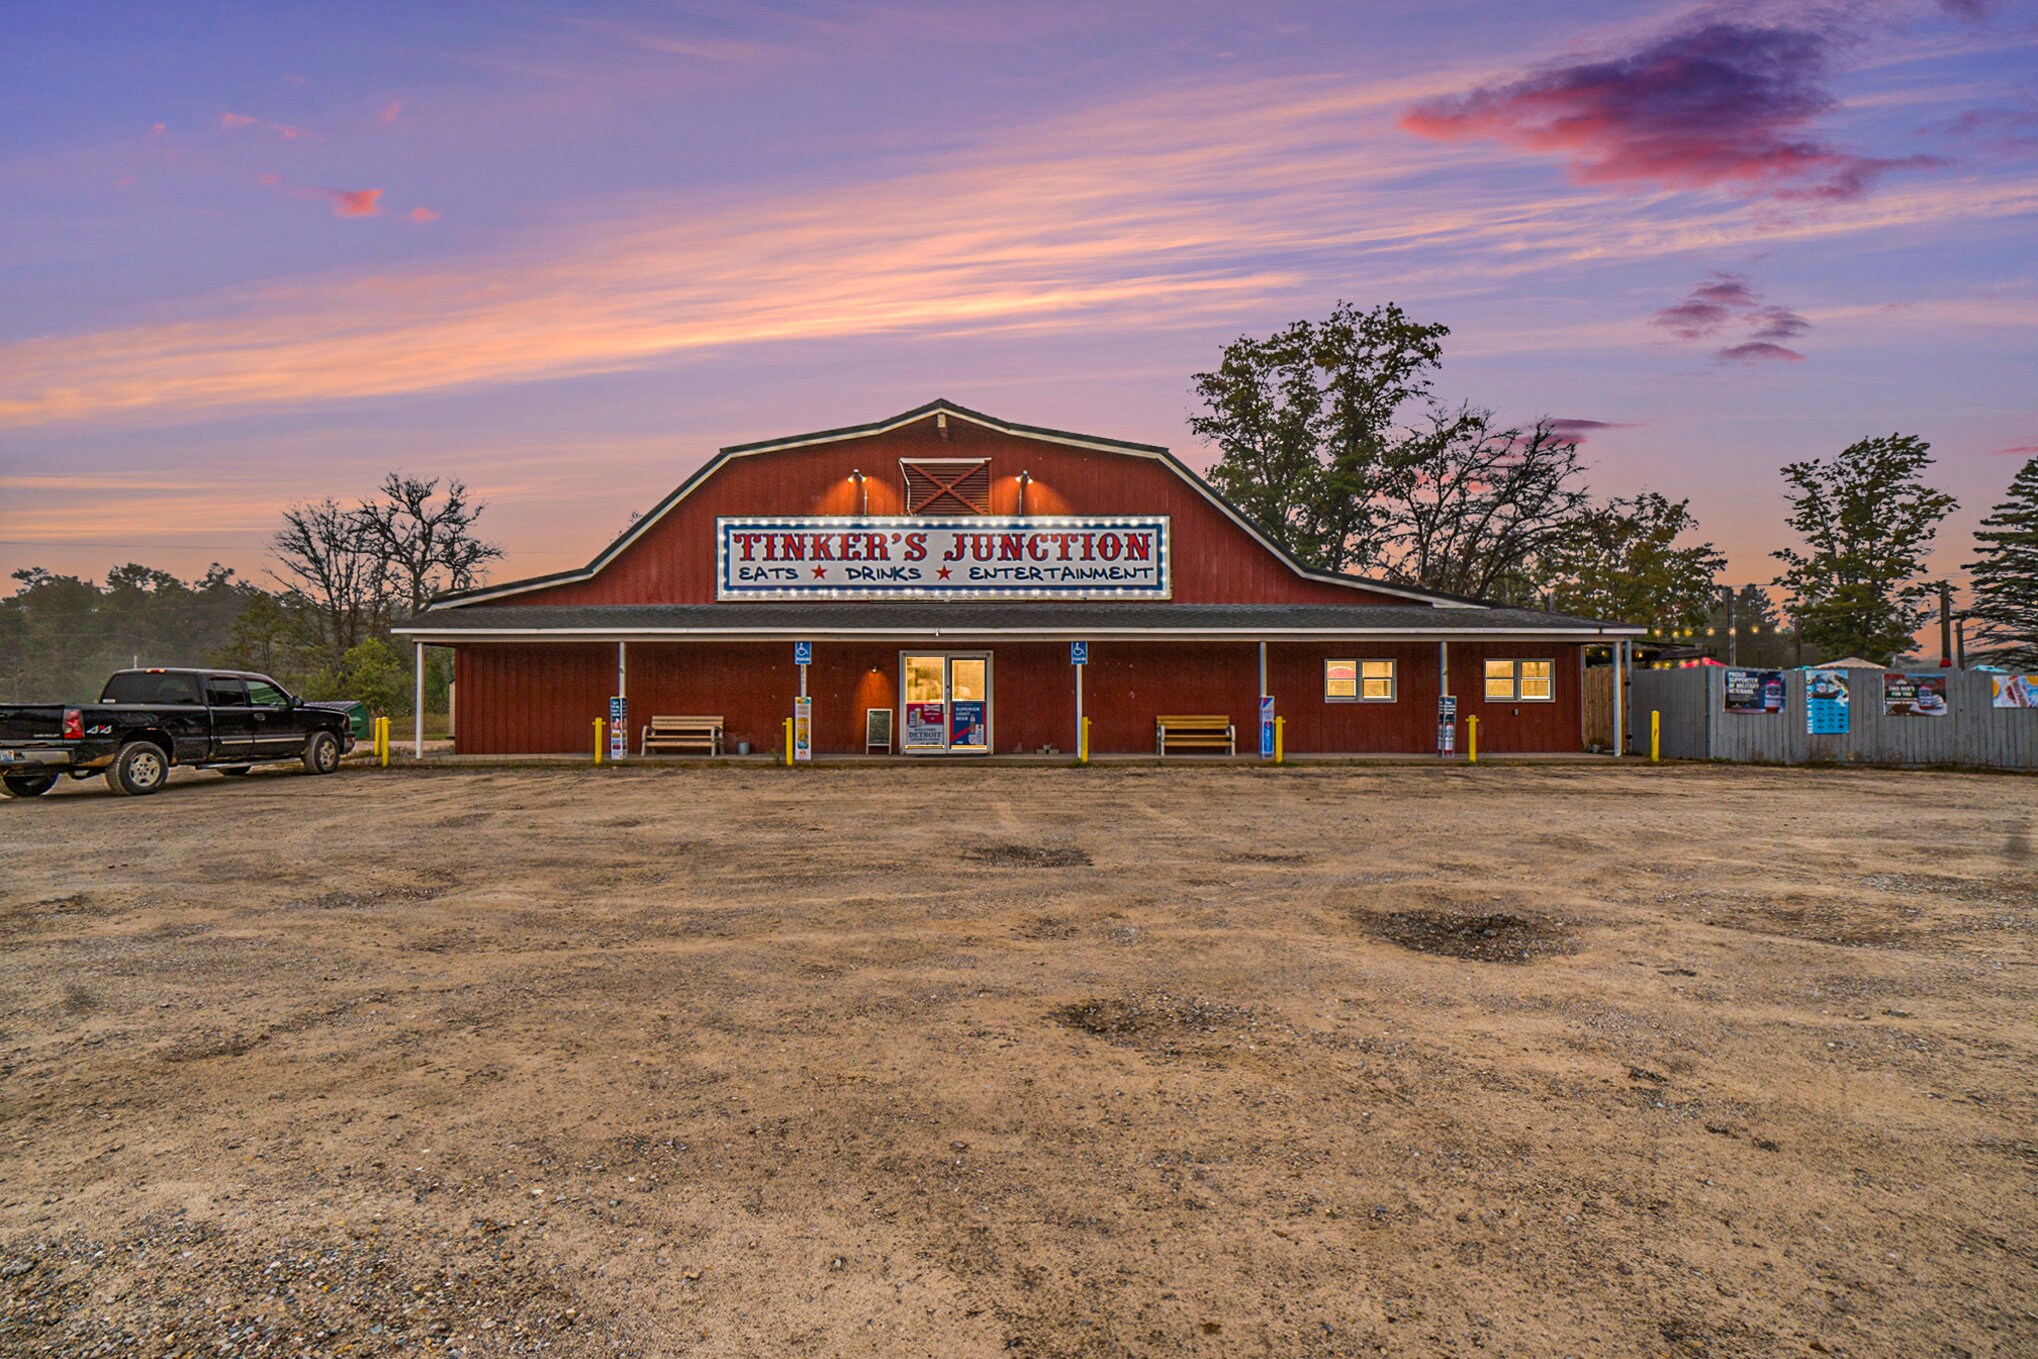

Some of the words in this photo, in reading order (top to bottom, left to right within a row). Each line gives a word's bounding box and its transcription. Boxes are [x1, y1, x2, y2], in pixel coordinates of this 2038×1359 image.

[732, 532, 928, 562] TINKER'S
[943, 532, 1153, 562] JUNCTION
[738, 566, 799, 582] EATS
[845, 565, 922, 582] DRINKS
[968, 565, 1154, 582] ENTERTAINMENT
